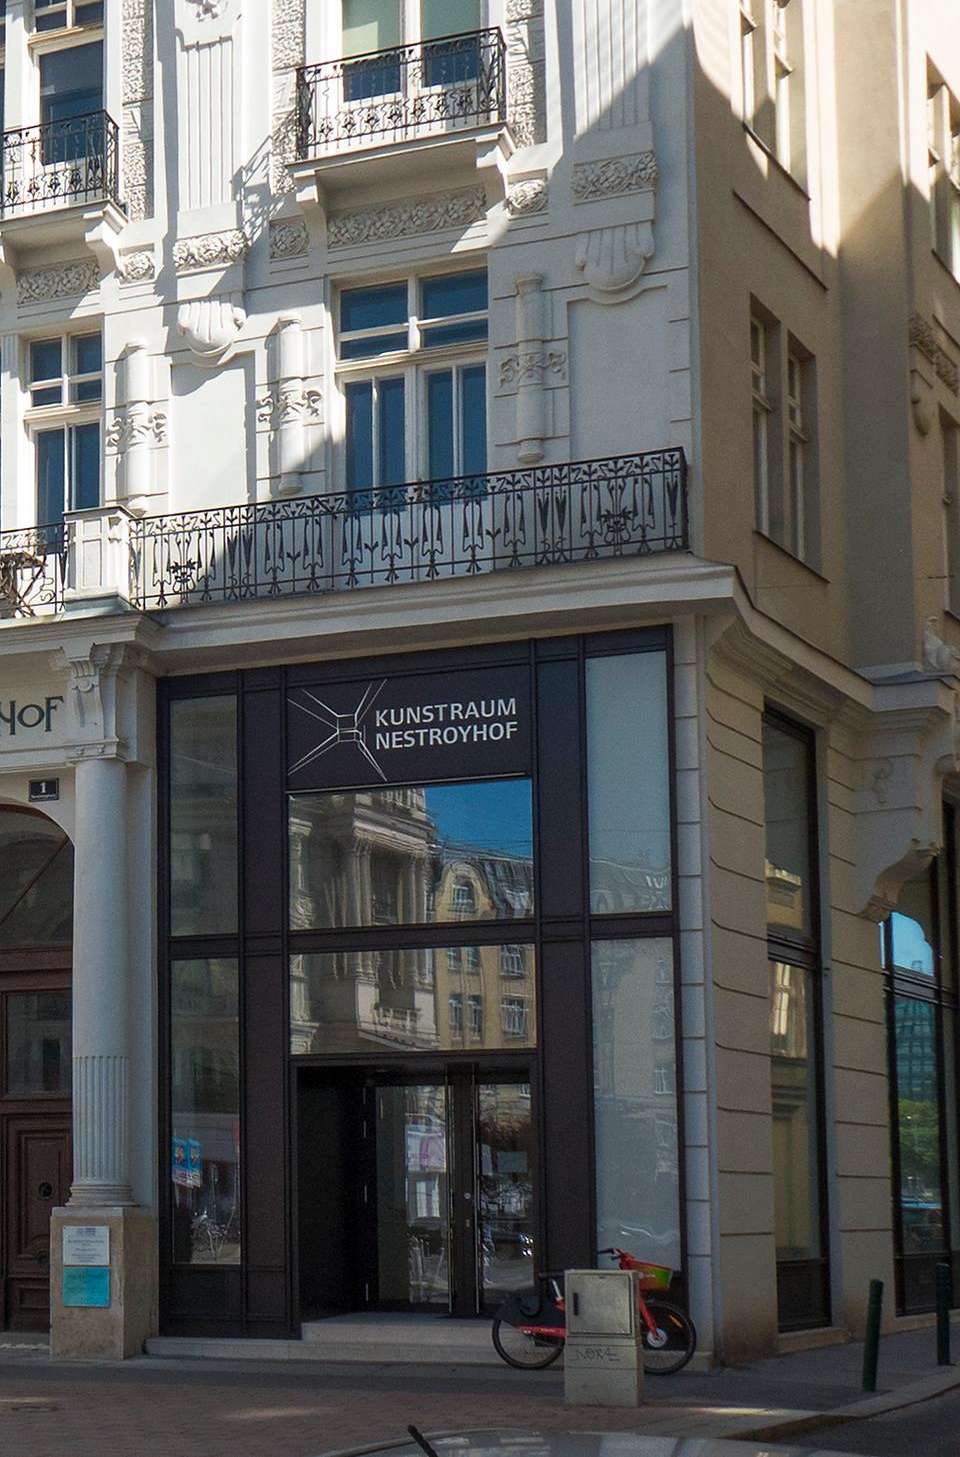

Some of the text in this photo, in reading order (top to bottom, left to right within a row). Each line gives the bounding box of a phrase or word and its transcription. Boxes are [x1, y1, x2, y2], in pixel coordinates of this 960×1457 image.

[375, 698, 516, 727] KUNSTRAUM
[375, 721, 518, 750] NESTROYHOF
[39, 781, 47, 794] 1
